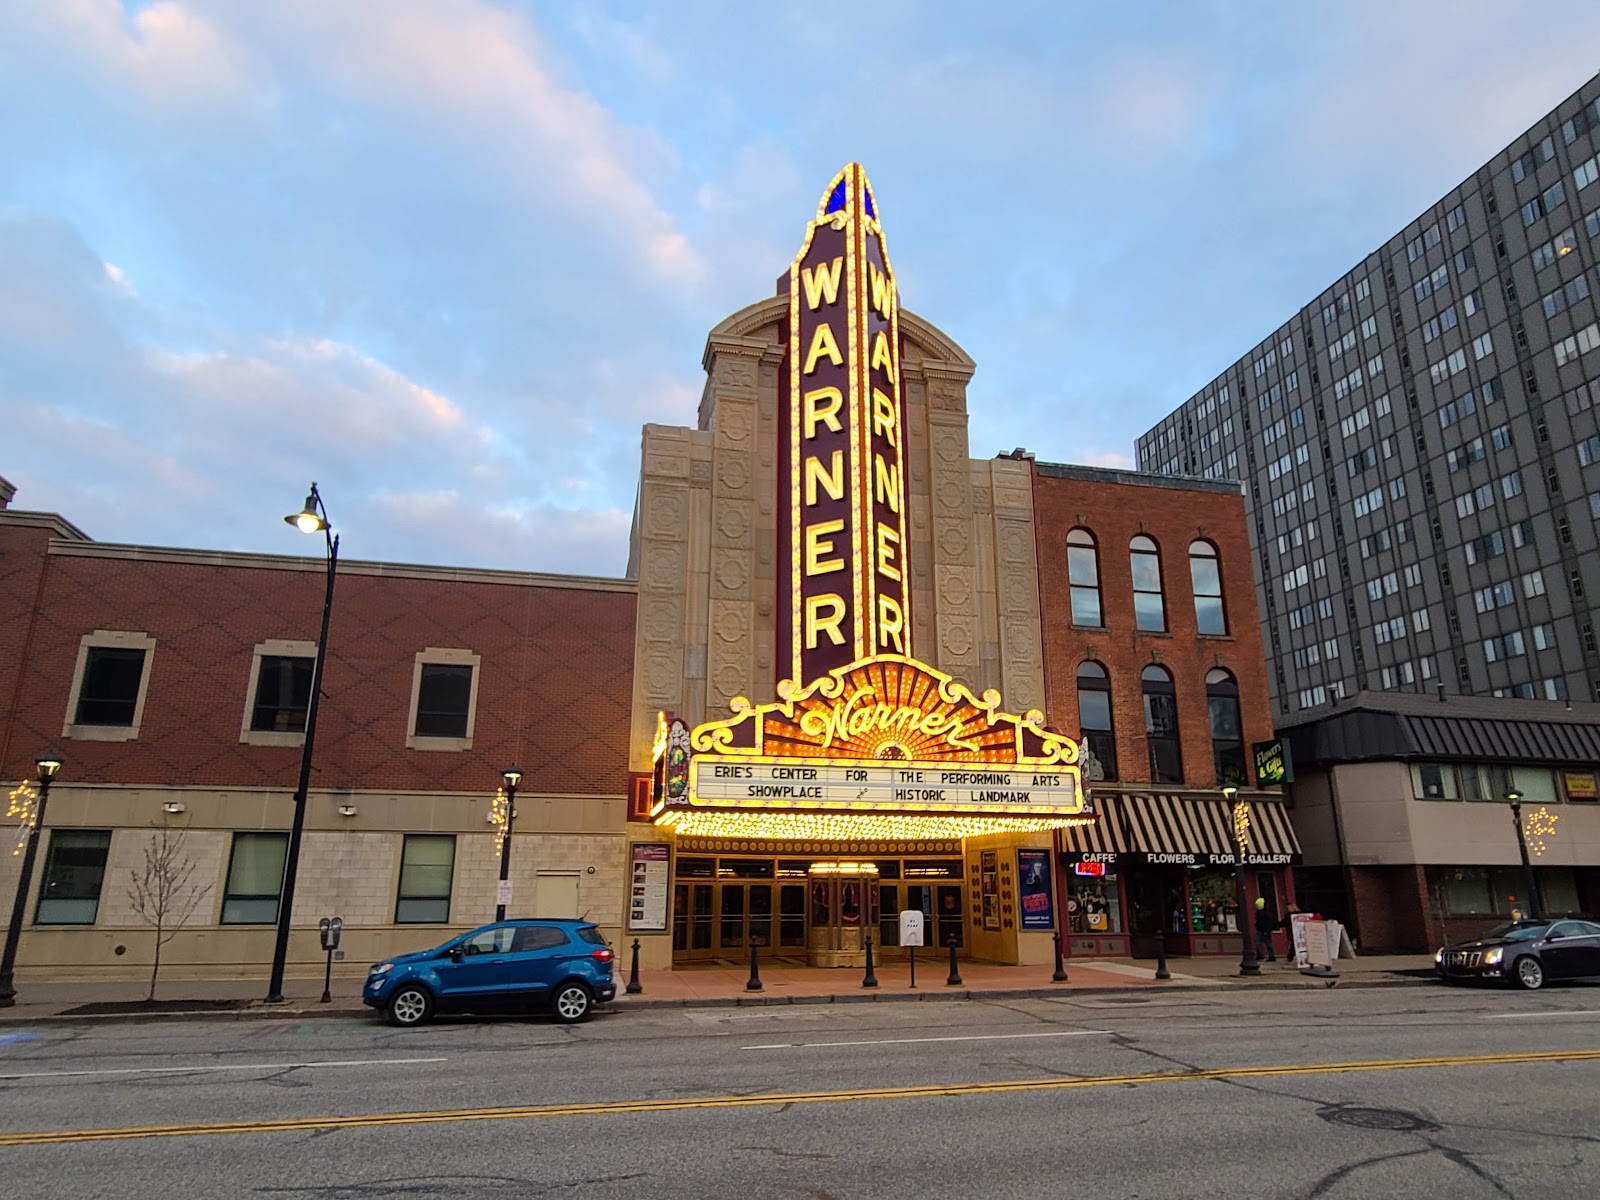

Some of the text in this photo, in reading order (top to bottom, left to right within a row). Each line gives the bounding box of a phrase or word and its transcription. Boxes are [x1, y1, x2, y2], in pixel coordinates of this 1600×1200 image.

[801, 256, 847, 650] WARNER
[869, 261, 904, 654] WARNER
[801, 686, 980, 752] Warner
[715, 766, 1060, 786] ERIE'S CENTER FOR THE PERFORMING ARTS
[748, 785, 823, 799] SHOWPLACE
[895, 789, 947, 801] HISTORIC
[971, 791, 1031, 803] LANDMARK
[1147, 853, 1292, 864] FLOWERS FLORL GALLERY
